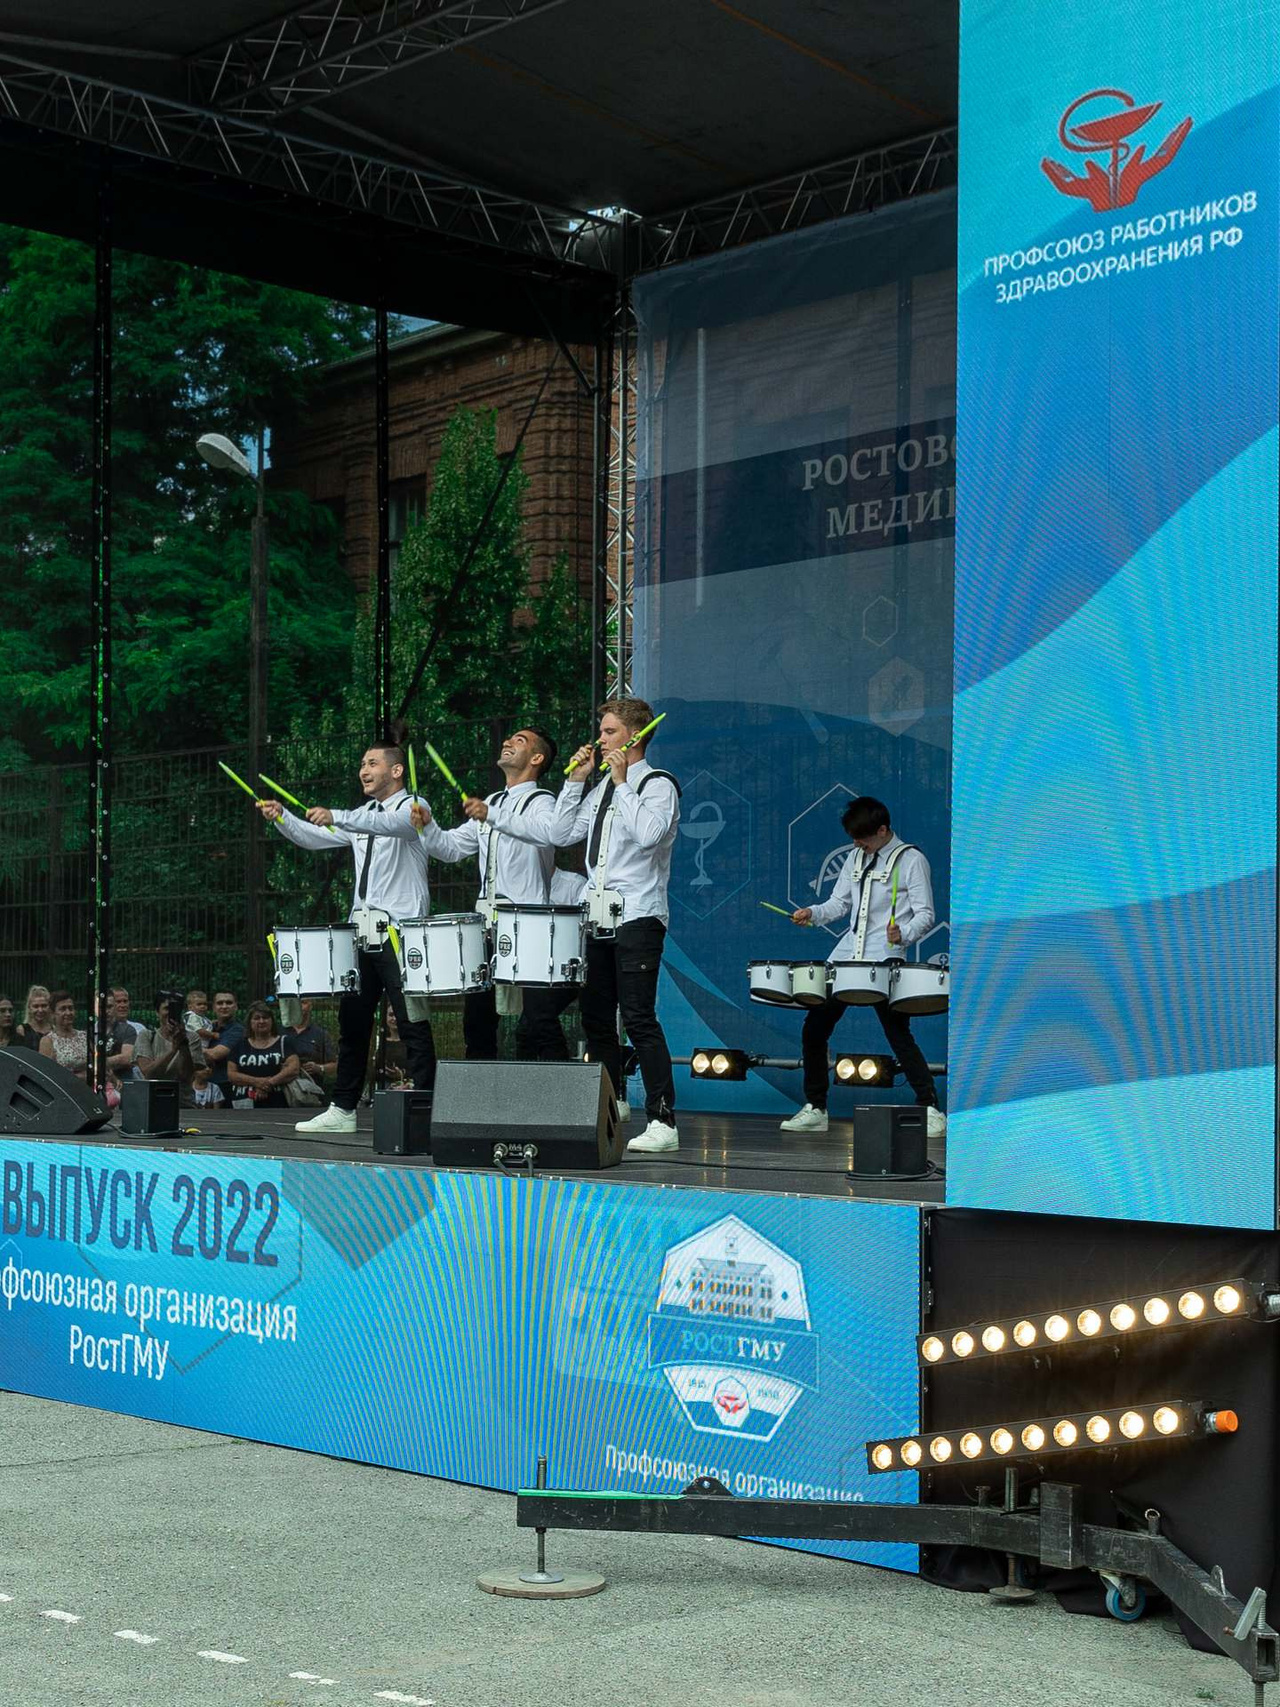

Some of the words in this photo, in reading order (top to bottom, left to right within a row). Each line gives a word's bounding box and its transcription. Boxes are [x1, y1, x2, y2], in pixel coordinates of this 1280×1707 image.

[984, 229, 1105, 277] ПРОФСОЮЗ
[1111, 190, 1258, 246] РАБОТНИКОВ
[996, 235, 1203, 304] ЗДРАВООХРАНЕНИЯ
[1210, 225, 1243, 252] РФ
[802, 434, 955, 491] РОСТОВ
[239, 1052, 281, 1067] CAN'T
[2, 1159, 159, 1253] ВЫПУСК
[172, 1174, 280, 1267] 2022
[124, 1282, 297, 1344] организация
[70, 1325, 170, 1381] РостГМУ
[682, 1329, 787, 1362] РОСТГМУ
